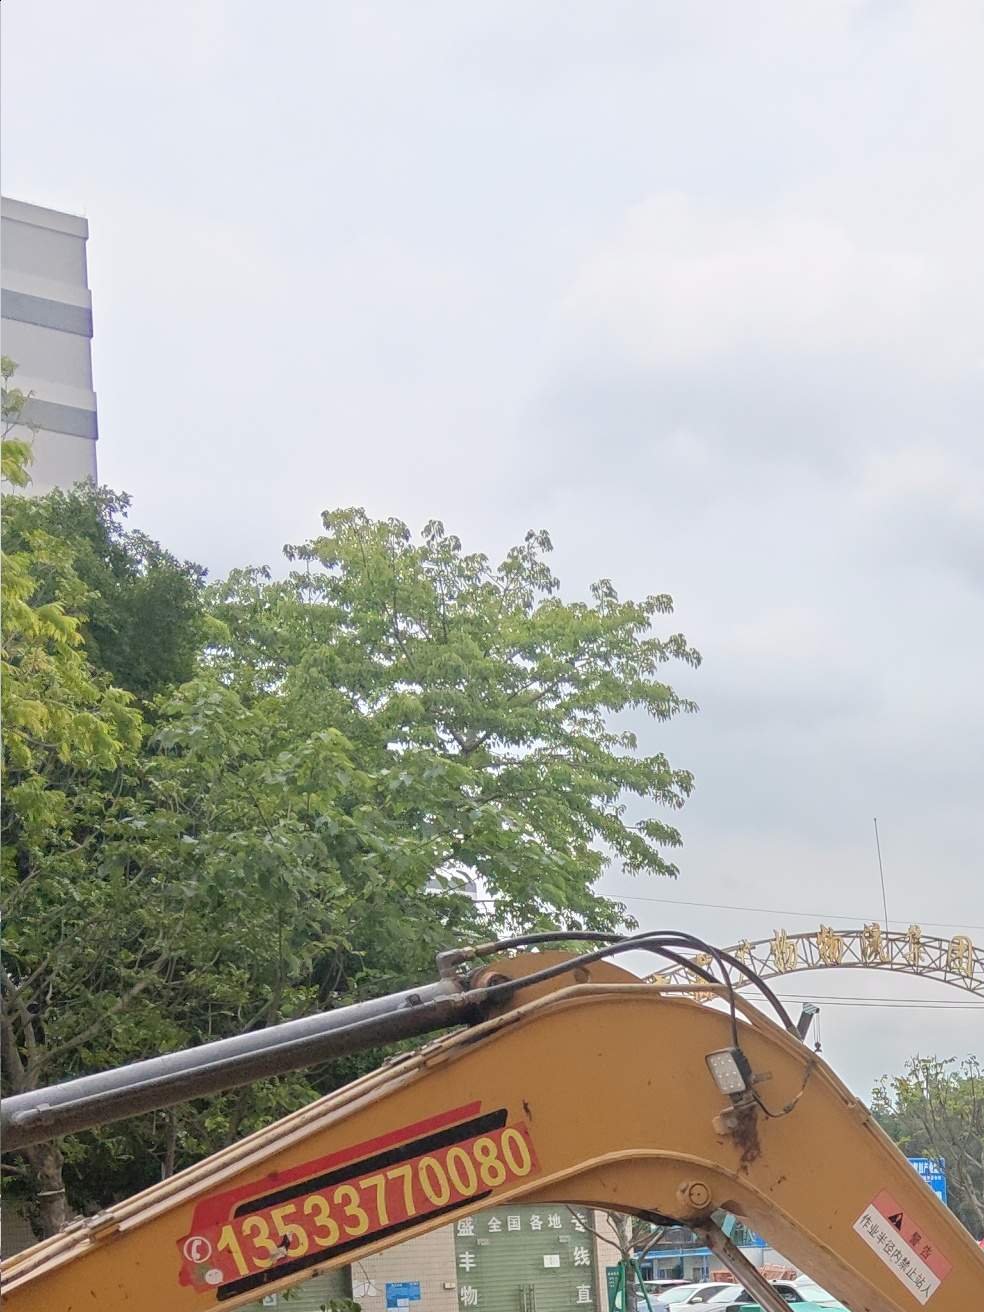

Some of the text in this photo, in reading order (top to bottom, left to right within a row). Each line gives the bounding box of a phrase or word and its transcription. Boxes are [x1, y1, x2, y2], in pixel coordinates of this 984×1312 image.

[217, 1128, 532, 1276] 13533770080
[860, 1213, 933, 1297] 作业半径内禁止站人
